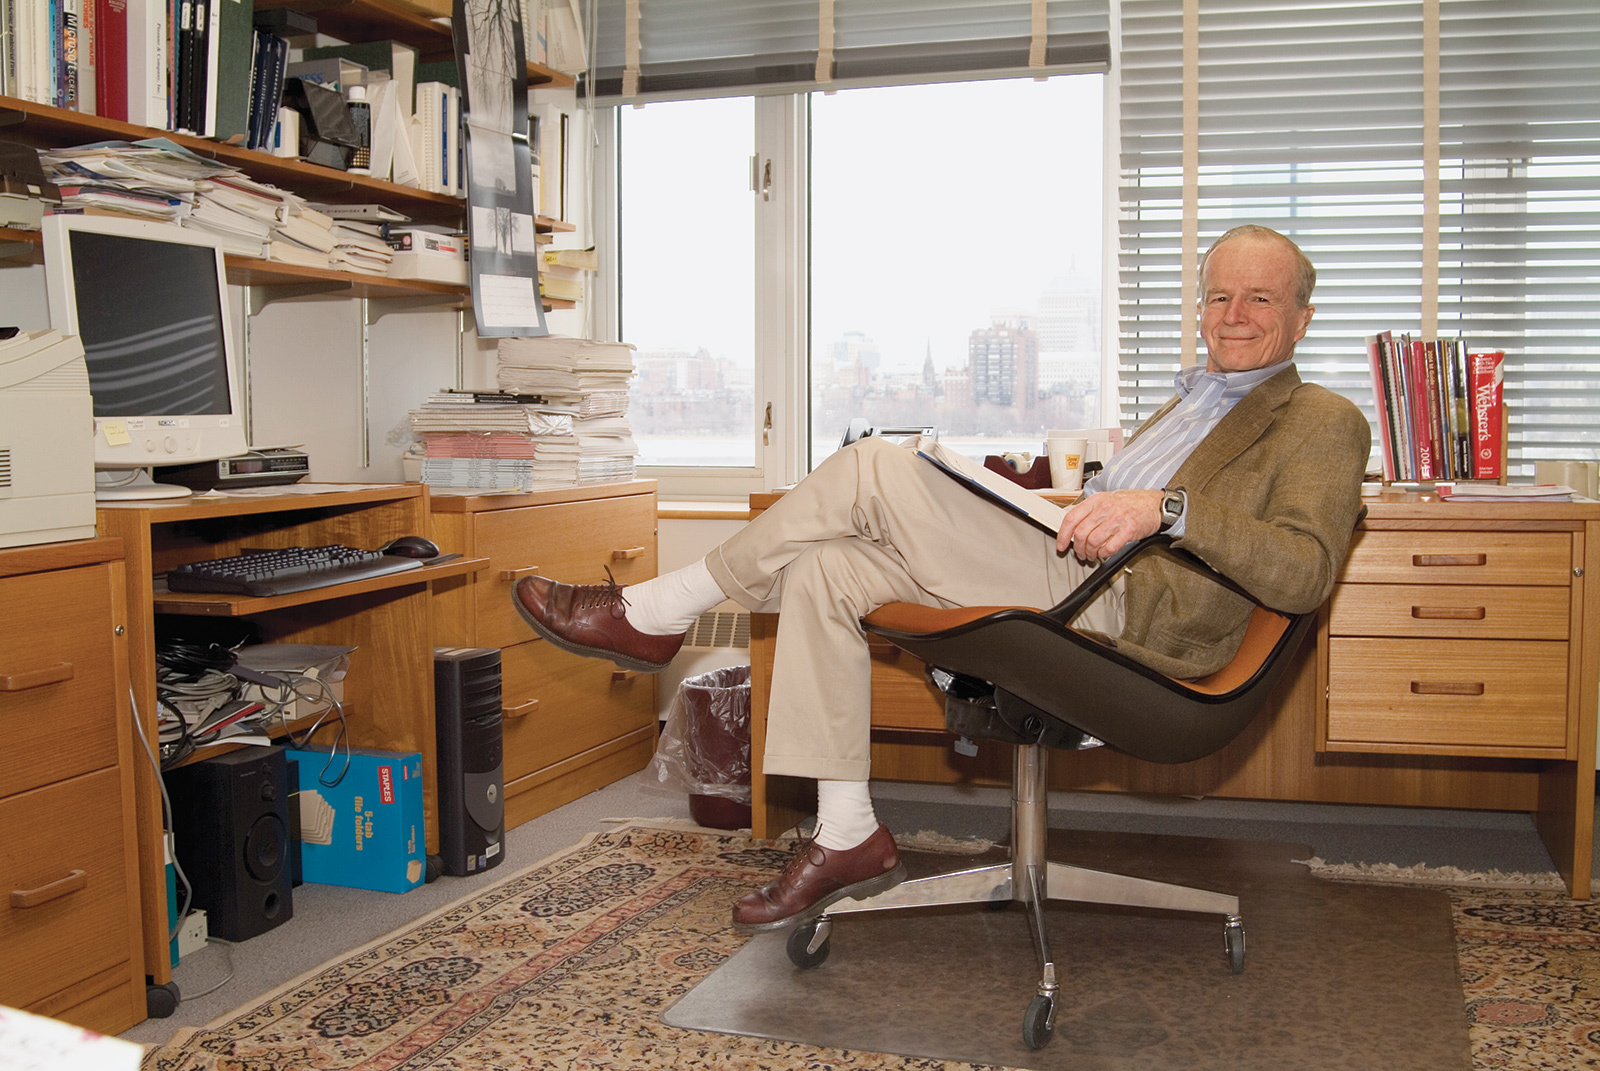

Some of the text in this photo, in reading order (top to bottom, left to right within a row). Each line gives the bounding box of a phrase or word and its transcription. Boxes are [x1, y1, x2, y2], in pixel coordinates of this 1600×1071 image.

[1477, 383, 1492, 441] Webster's
[381, 768, 392, 802] STAPLES
[354, 796, 363, 851] file folders
[364, 810, 373, 839] 5-tab
